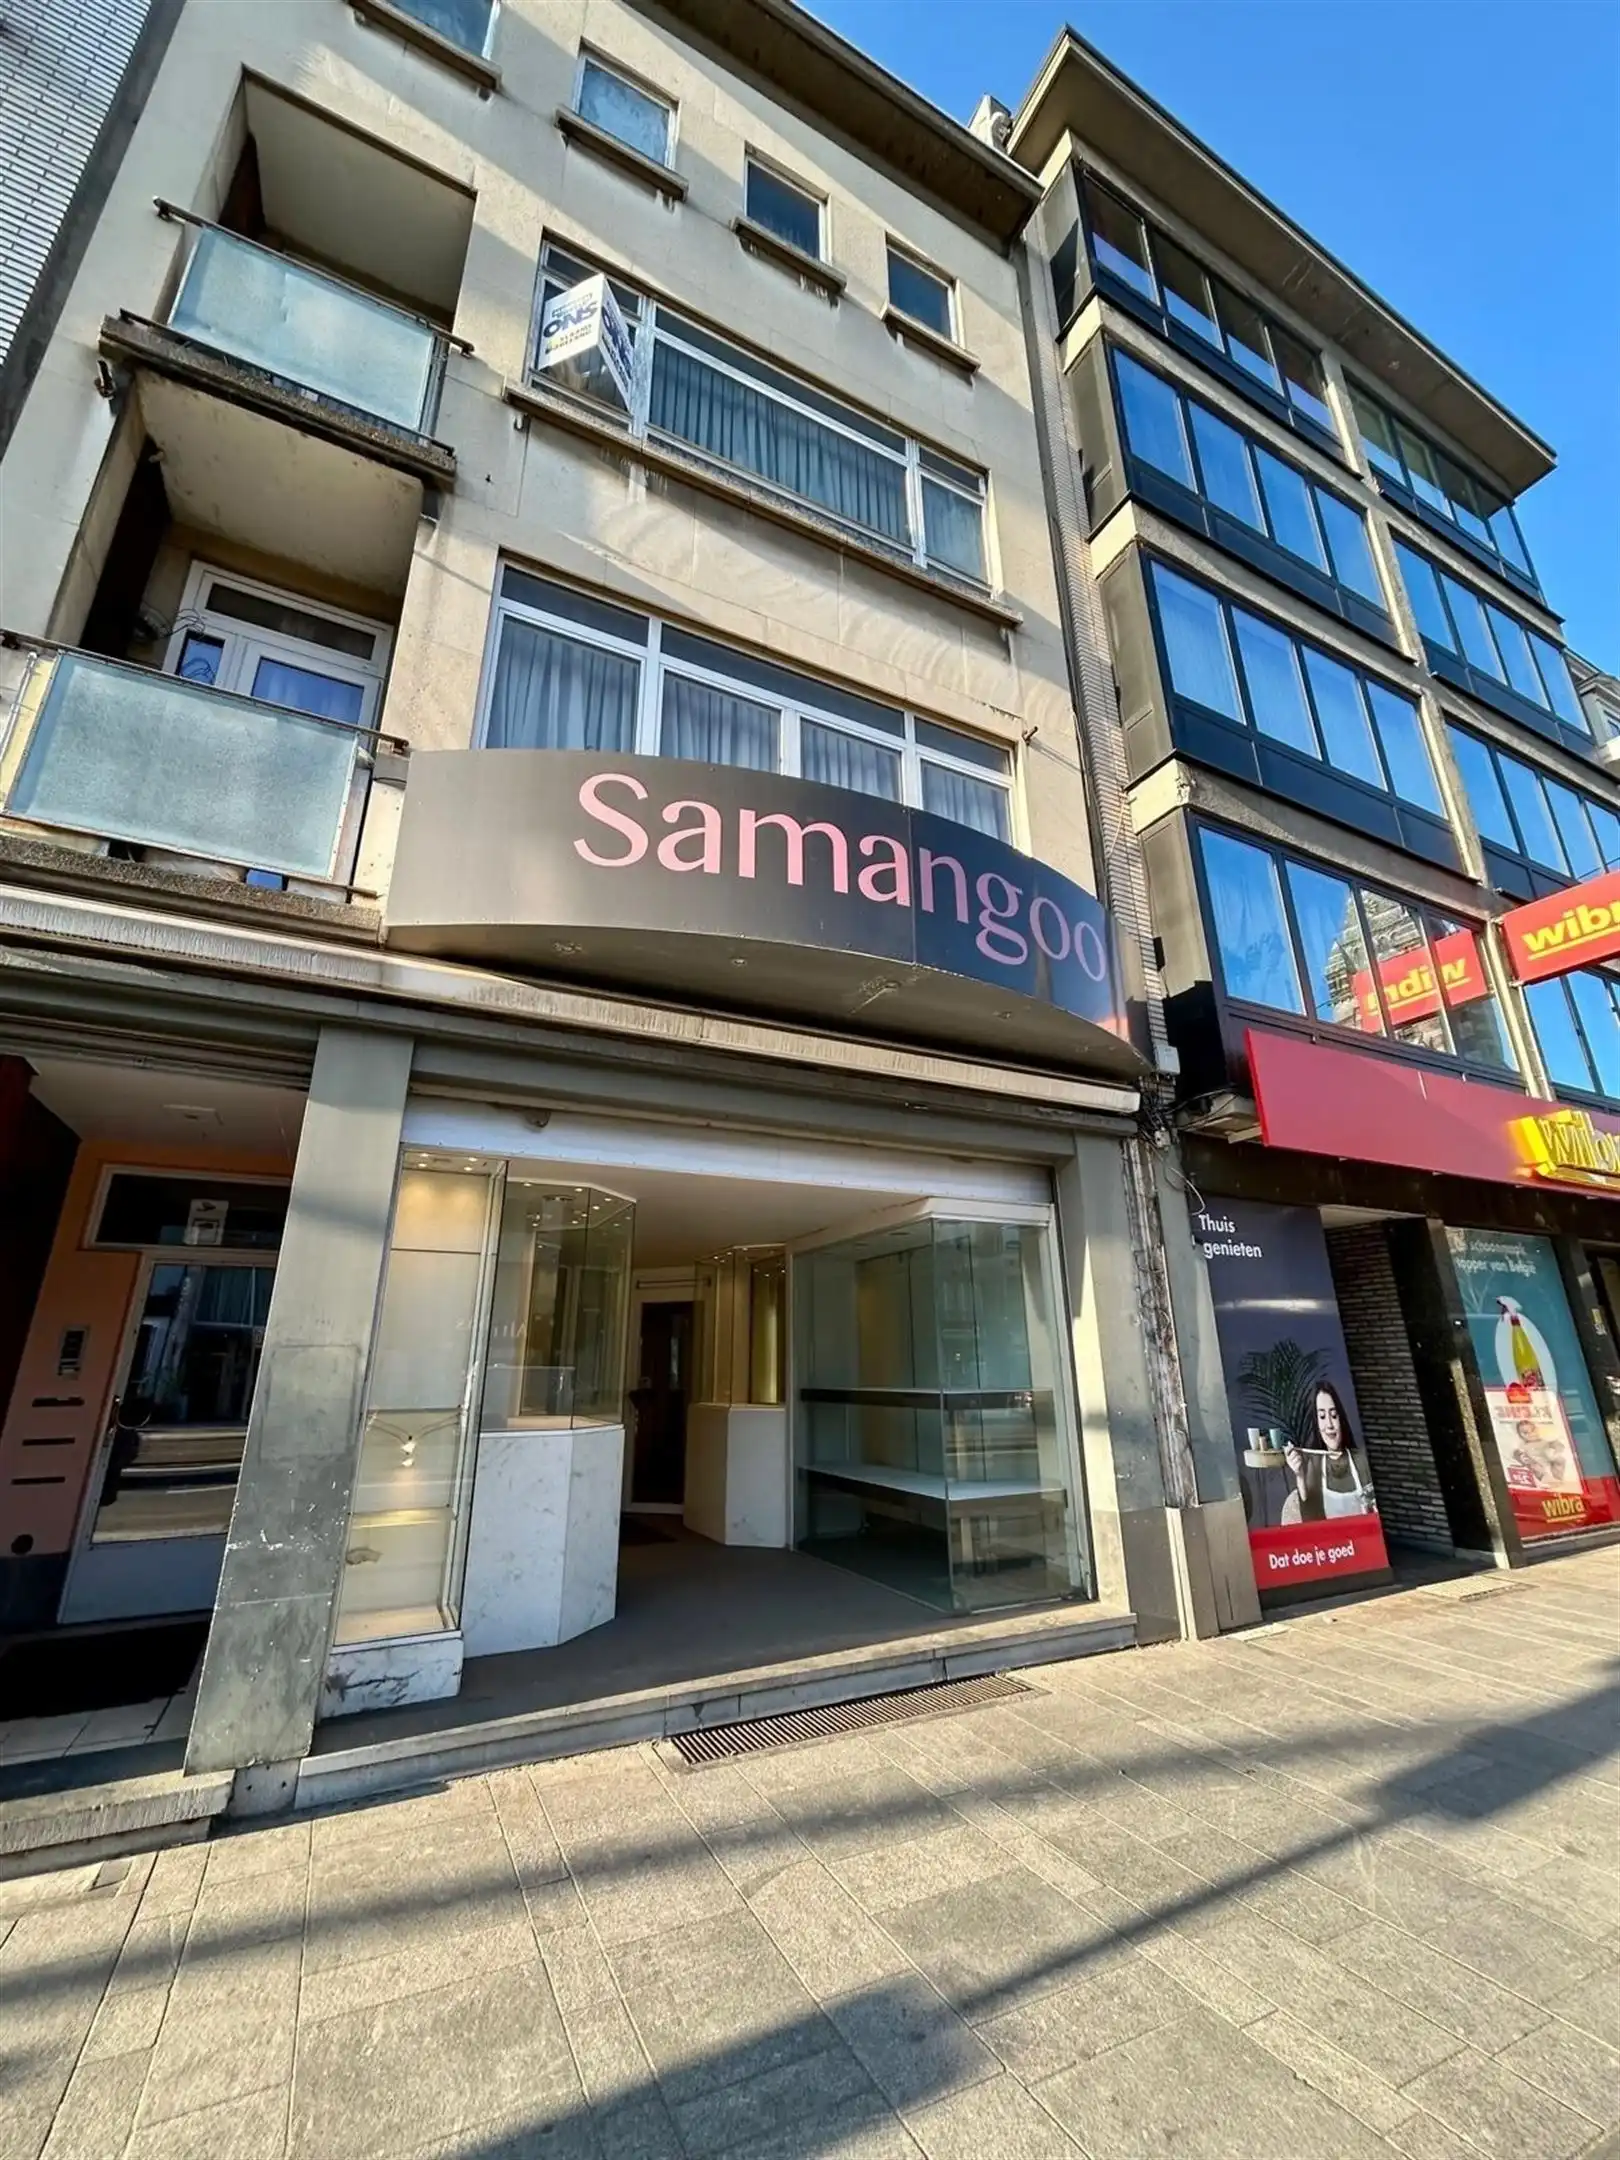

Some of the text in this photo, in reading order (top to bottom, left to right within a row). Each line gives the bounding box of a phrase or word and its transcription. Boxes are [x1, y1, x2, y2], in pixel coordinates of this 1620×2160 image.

[543, 301, 598, 338] ONS
[574, 772, 1106, 982] Samangoo
[1199, 1213, 1236, 1233] Thuis
[1203, 1239, 1262, 1259] genieten
[1541, 1493, 1585, 1518] wibra
[1268, 1540, 1355, 1569] Dat doe je goed
